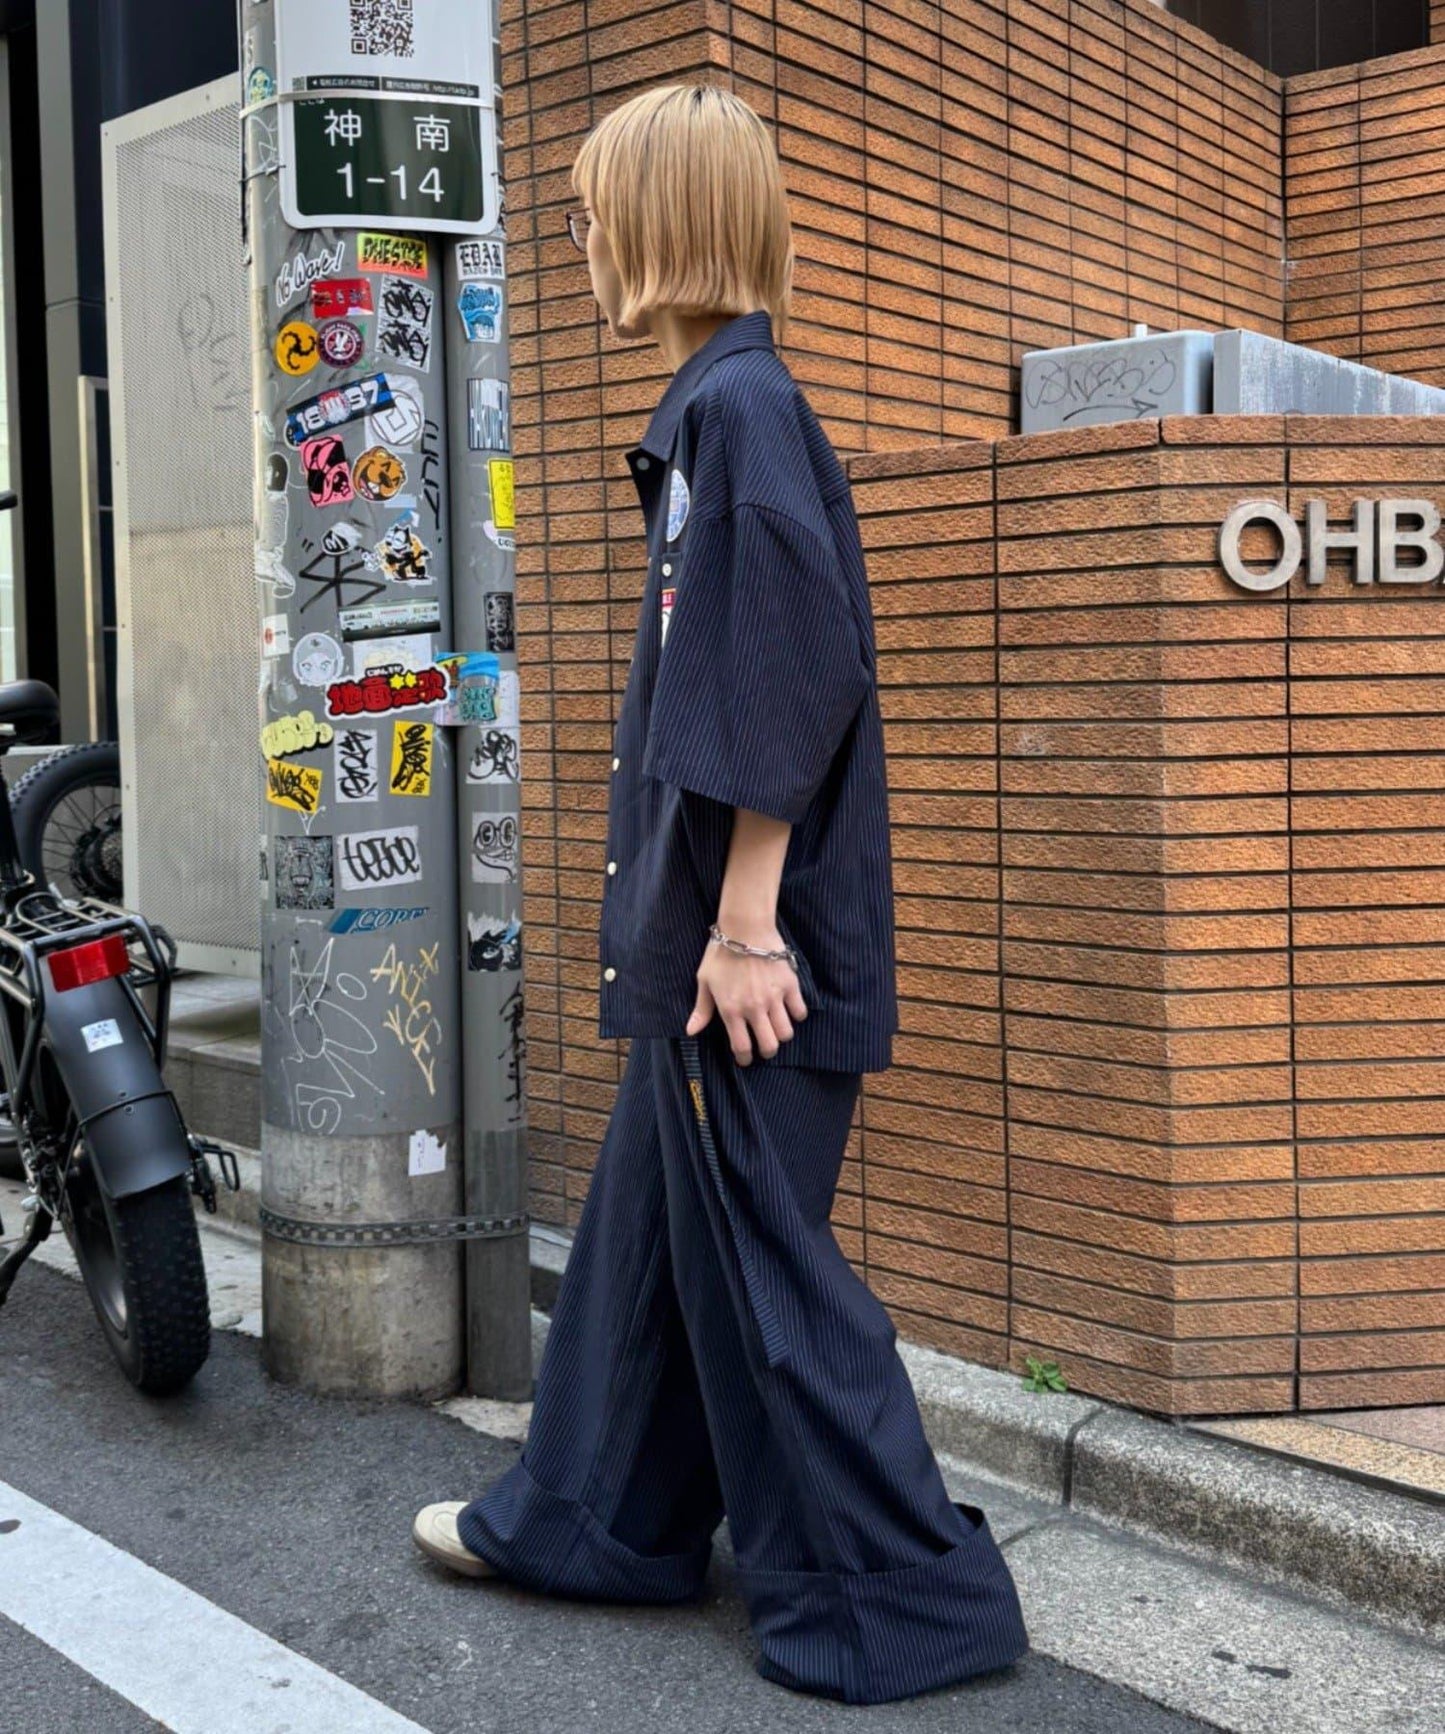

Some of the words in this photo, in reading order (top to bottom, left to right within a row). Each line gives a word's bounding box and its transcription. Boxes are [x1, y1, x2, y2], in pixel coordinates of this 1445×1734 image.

[324, 109, 451, 152] 神南
[337, 162, 445, 202] 1-14
[296, 405, 326, 434] 18
[1219, 499, 1445, 592] OHB
